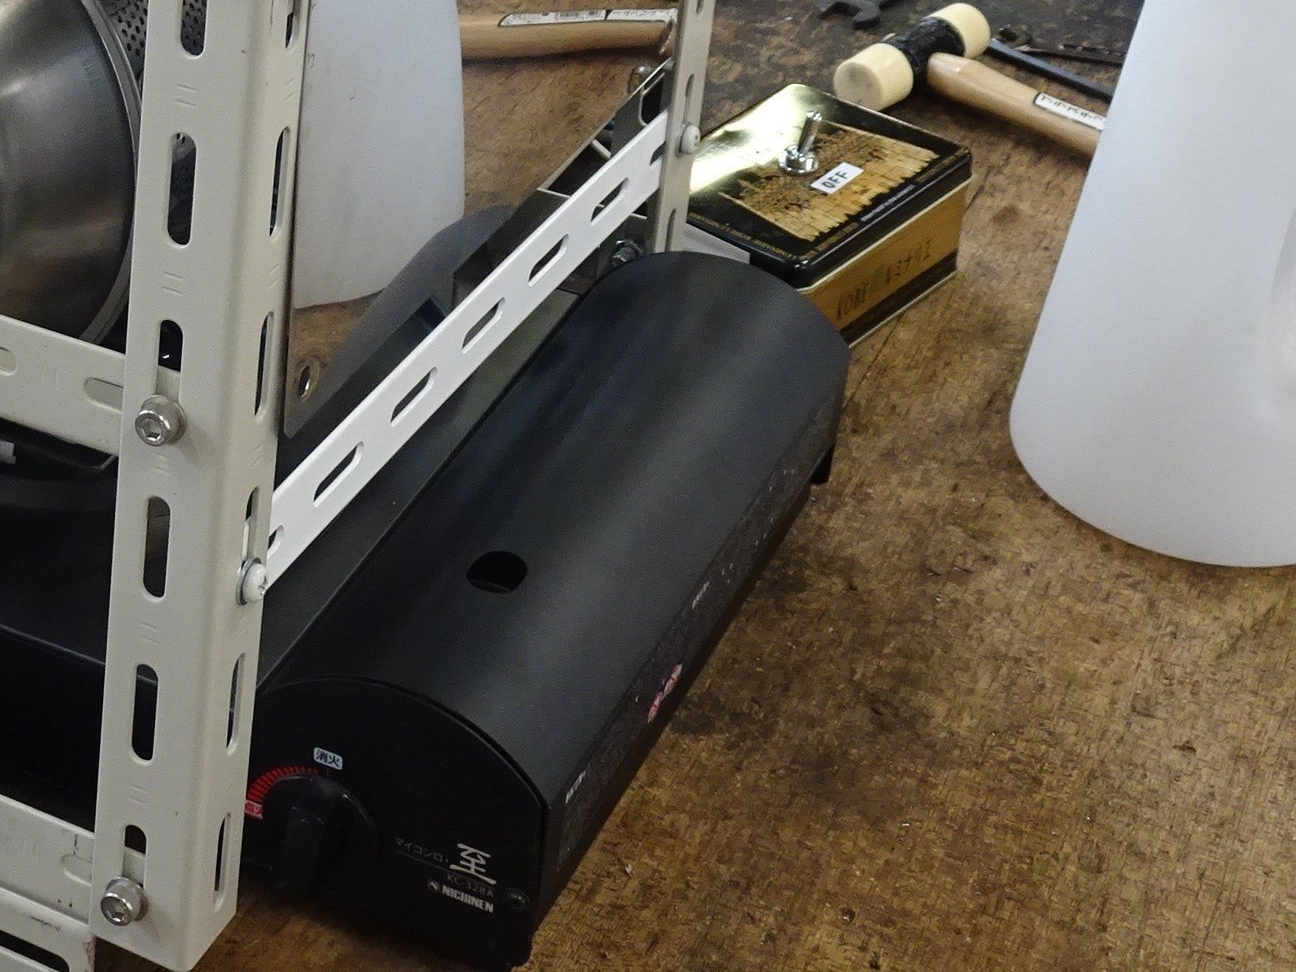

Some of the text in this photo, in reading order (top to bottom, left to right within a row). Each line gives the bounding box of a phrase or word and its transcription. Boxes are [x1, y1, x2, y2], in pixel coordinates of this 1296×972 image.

[822, 171, 848, 188] OFF
[316, 749, 341, 768] 消火
[441, 884, 494, 913] NICHINEN
